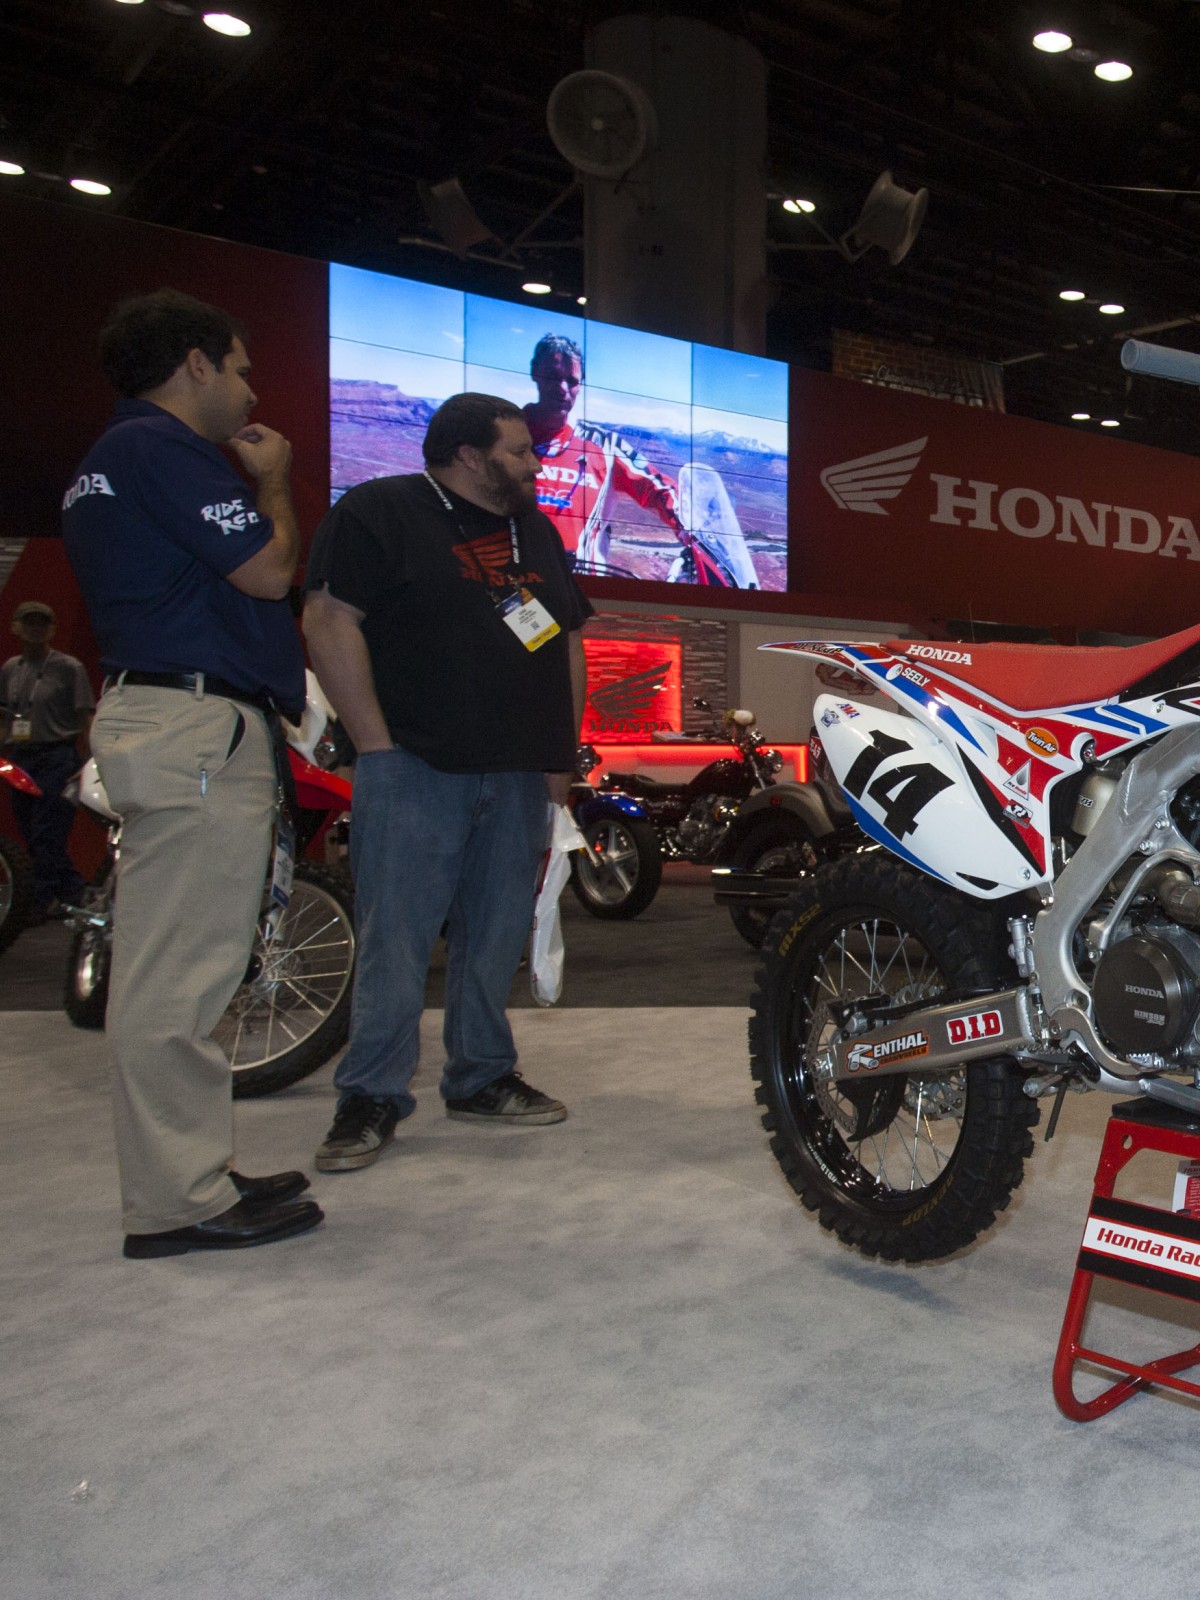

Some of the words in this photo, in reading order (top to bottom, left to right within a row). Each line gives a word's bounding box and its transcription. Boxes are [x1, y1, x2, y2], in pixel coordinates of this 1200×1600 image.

[536, 464, 600, 490] NDA
[201, 499, 246, 522] RIDE
[217, 511, 260, 535] RED
[905, 644, 973, 666] HONDA
[901, 666, 931, 687] SEELY
[590, 720, 675, 733] HONDA
[1027, 731, 1046, 747] Twin
[1042, 743, 1058, 754] Air
[842, 729, 956, 842] 14
[1125, 984, 1165, 999] HONDA
[950, 1012, 1000, 1043] D.I.D
[847, 1032, 928, 1072] RENTHAL
[1097, 1227, 1165, 1257] Honda
